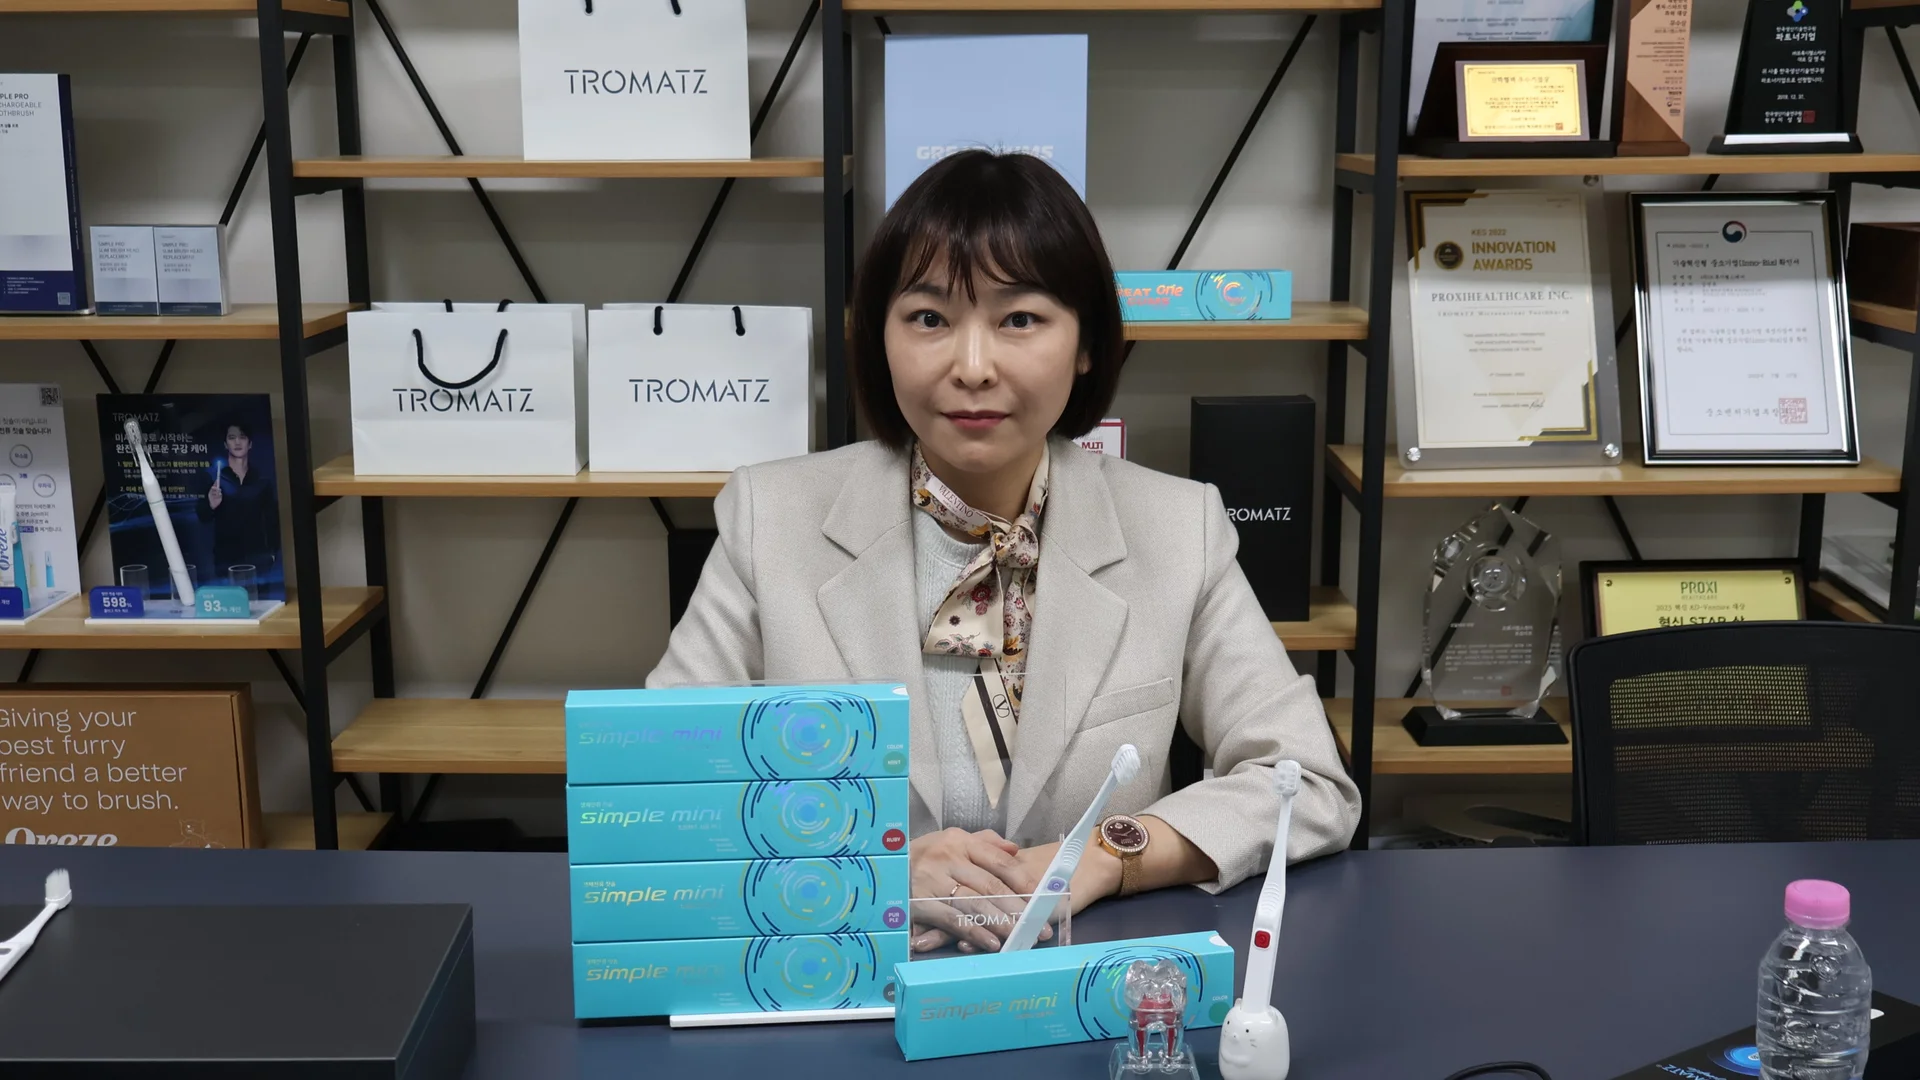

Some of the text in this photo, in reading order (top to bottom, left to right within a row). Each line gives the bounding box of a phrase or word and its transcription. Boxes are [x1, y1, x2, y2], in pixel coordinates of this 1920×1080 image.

[1775, 32, 1816, 41] 파트너기업
[564, 69, 708, 94] TROMATZ
[1471, 240, 1556, 255] INNOVATION
[1473, 257, 1533, 271] AWARDS
[1431, 290, 1573, 302] PROXIHEALTHCARE INC.
[393, 388, 534, 412] TROMATZ
[629, 378, 770, 403] TROMATZ
[160, 432, 194, 442] 시작하는
[171, 443, 188, 453] 구강
[190, 443, 208, 454] 케어
[939, 484, 974, 518] VALENTINO
[1681, 581, 1717, 594] PROXI
[1690, 615, 1726, 625] STAR
[0, 708, 137, 733] Giving your
[62, 734, 126, 759] furry
[579, 725, 723, 748] simple mini
[0, 762, 187, 783] friend a better
[1, 790, 179, 815] way to brush.
[580, 804, 723, 827] simple mini
[583, 884, 725, 906] simple mini
[586, 964, 725, 983] simple mini
[919, 1001, 1002, 1020] simple
[1008, 992, 1058, 1012] mini
